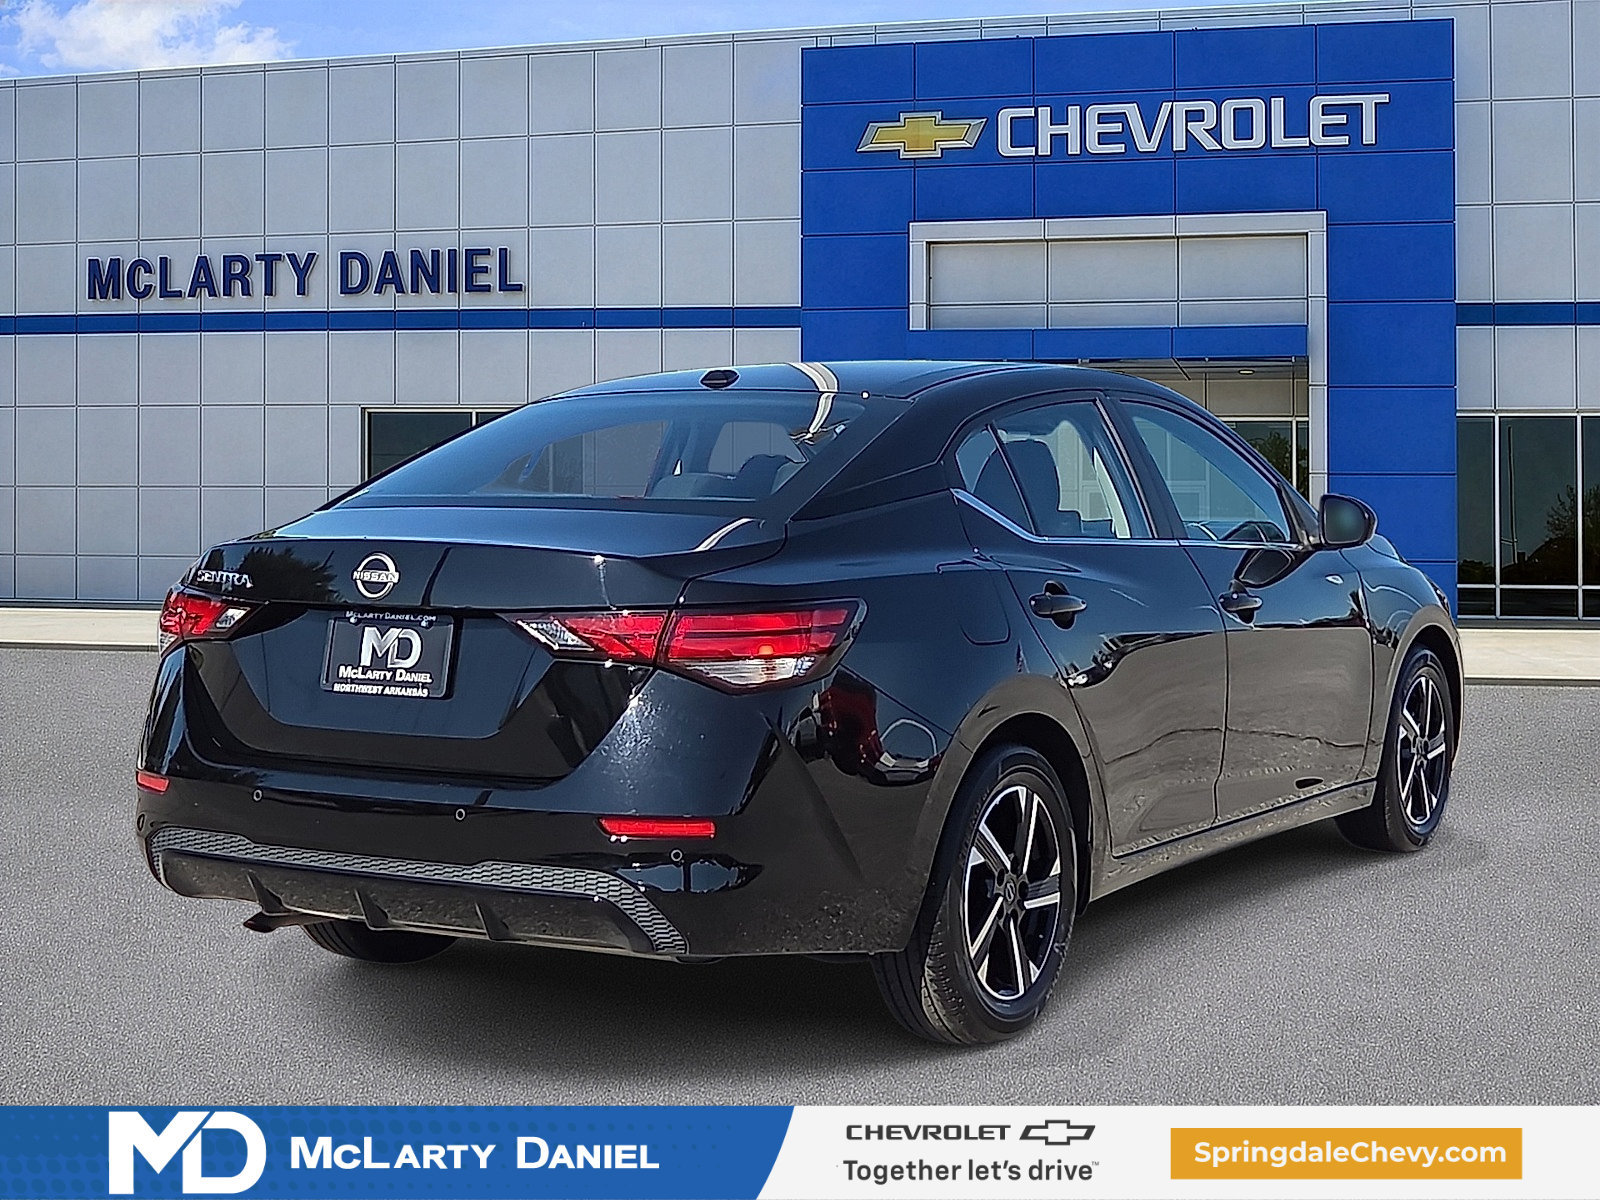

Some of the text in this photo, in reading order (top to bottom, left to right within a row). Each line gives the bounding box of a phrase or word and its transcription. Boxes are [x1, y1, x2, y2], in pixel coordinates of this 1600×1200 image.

[997, 93, 1390, 157] CHEVROLET
[87, 247, 525, 300] MCLARTY DANIEL
[197, 570, 254, 588] SENTRA
[353, 570, 399, 583] NISSAN
[360, 626, 421, 668] MD
[395, 669, 432, 682] DANIEL
[333, 683, 428, 697] NORTHWEST ARKANSAS
